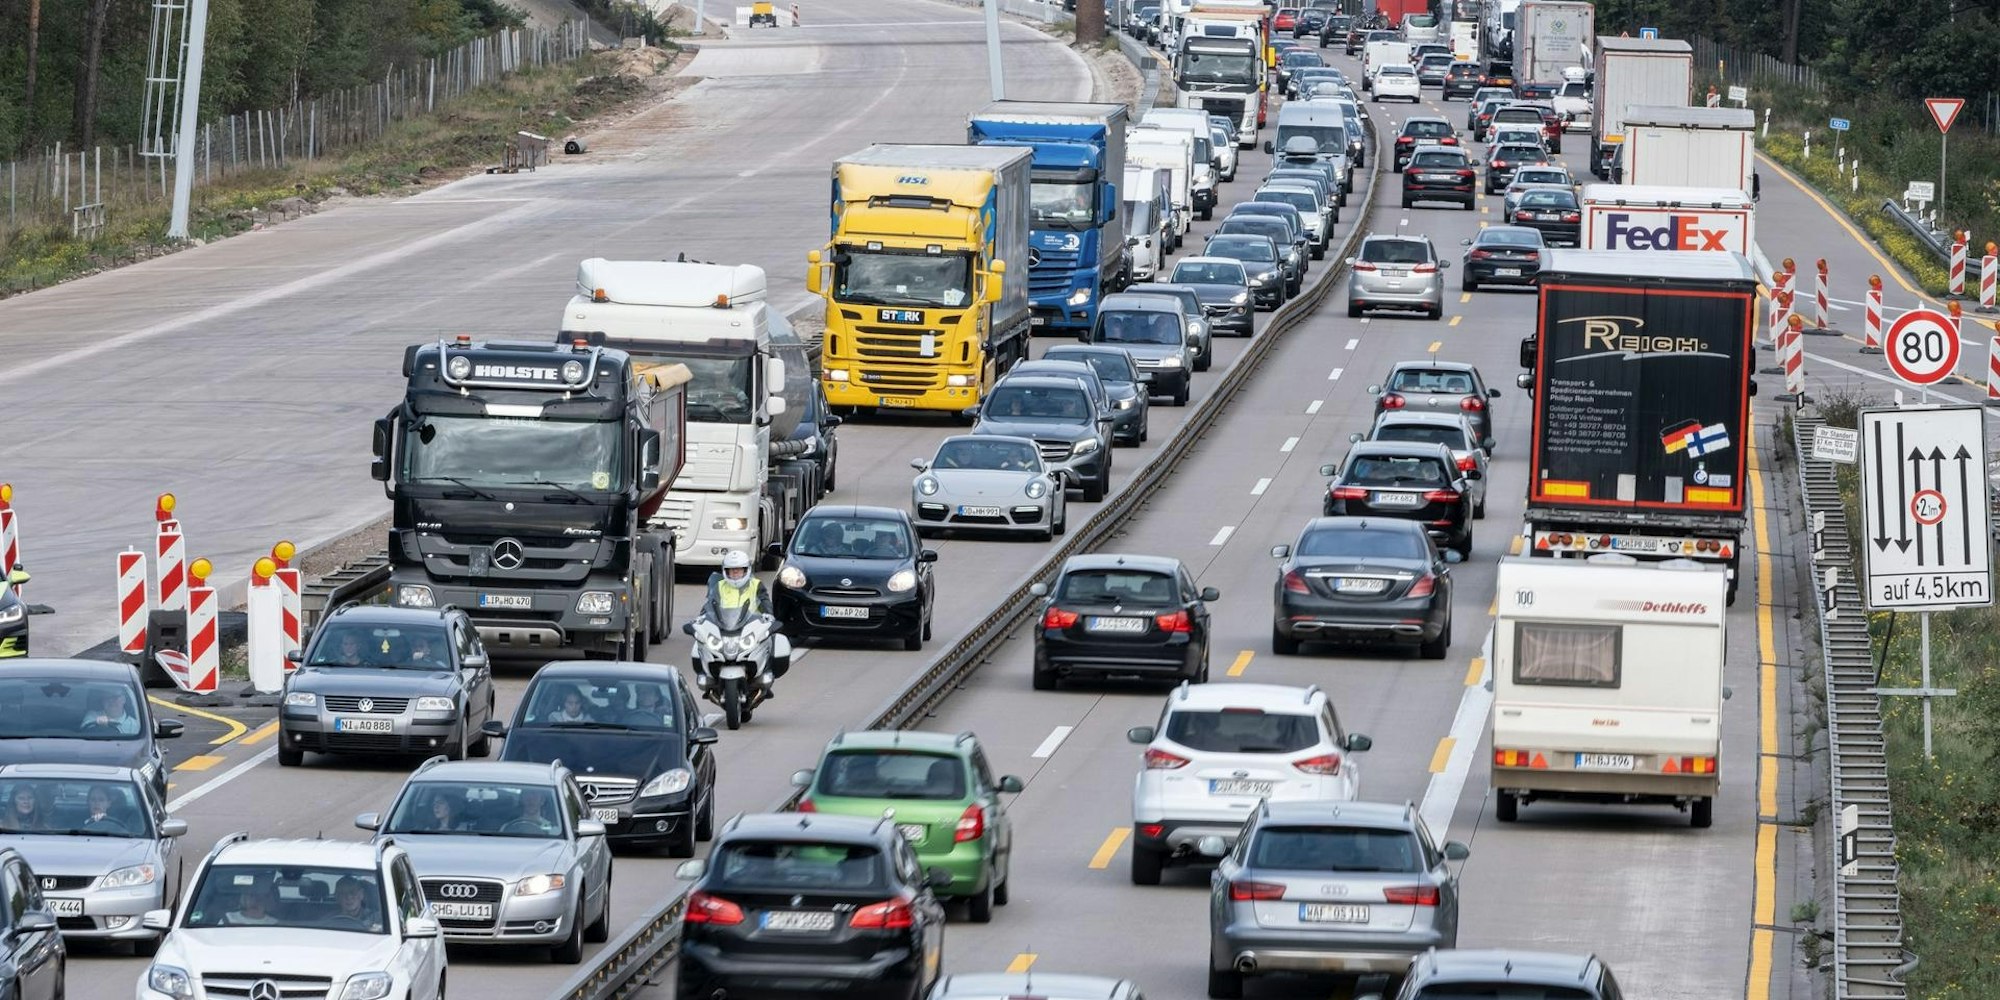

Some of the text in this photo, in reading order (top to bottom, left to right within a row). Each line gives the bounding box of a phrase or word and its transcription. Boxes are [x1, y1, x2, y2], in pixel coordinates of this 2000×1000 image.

[898, 176, 928, 185] HSL
[1606, 213, 1729, 252] FedEx
[1902, 331, 1944, 364] 80
[474, 364, 559, 380] HOLSTE
[1550, 378, 1588, 388] Transport-
[1574, 395, 1595, 403] Reich
[1883, 578, 1911, 602] auf
[486, 596, 530, 606] LIP HO 470
[1516, 590, 1534, 605] 100
[1641, 601, 1708, 615] Dethleffs
[341, 720, 391, 731] NI AQ 888
[1611, 755, 1630, 767] 196
[598, 810, 617, 821] 988
[59, 901, 80, 913] 444
[431, 903, 491, 917] SHG LU 11
